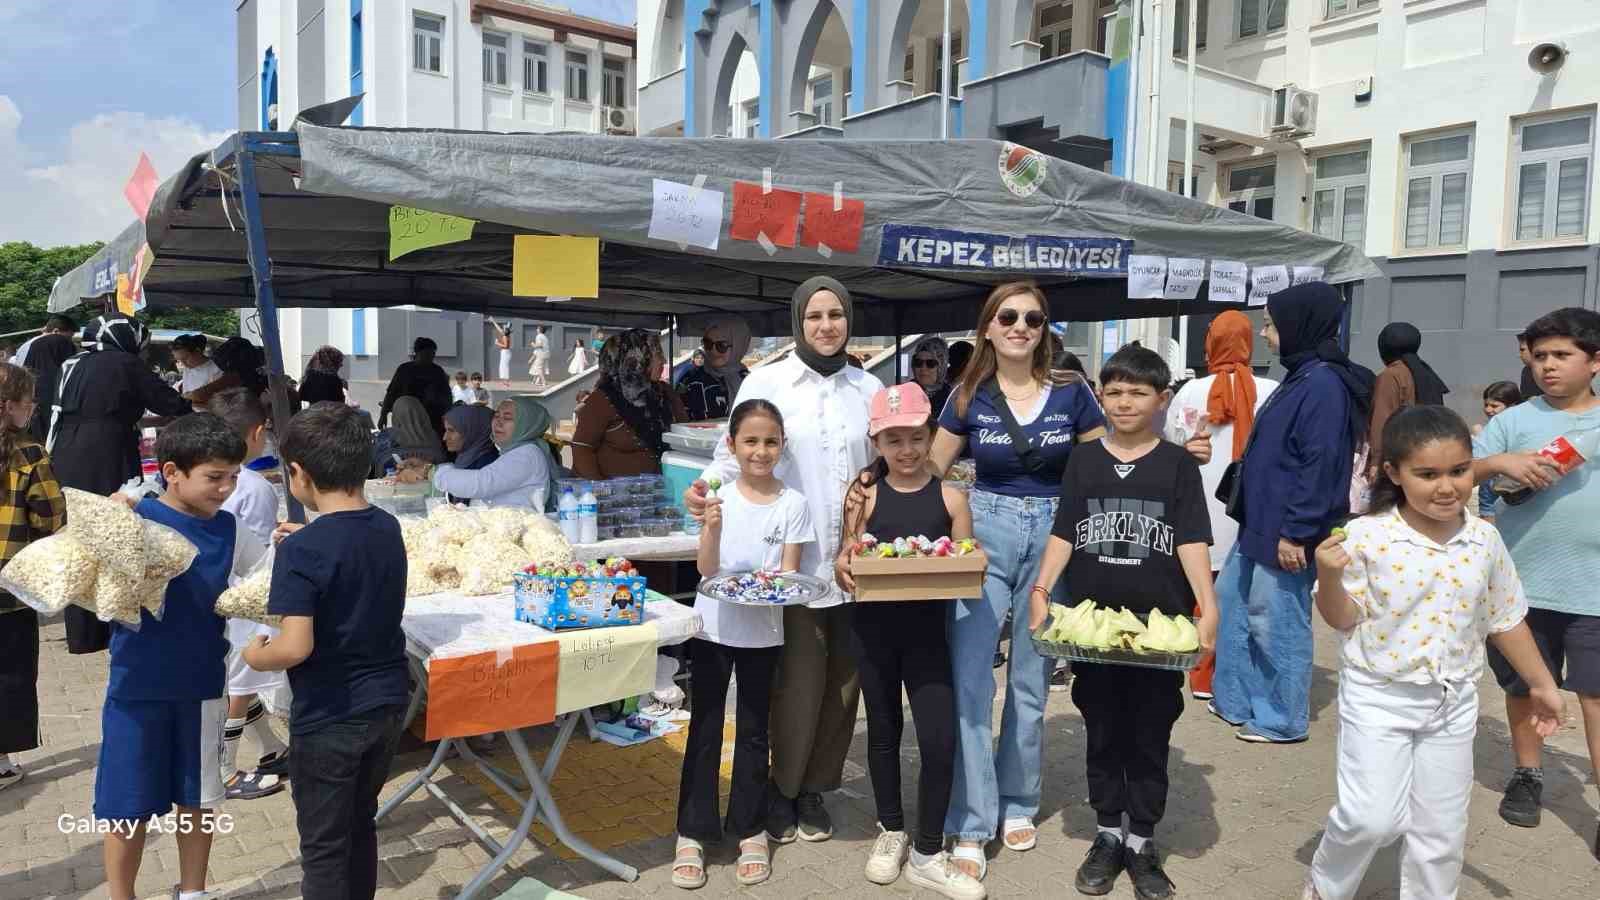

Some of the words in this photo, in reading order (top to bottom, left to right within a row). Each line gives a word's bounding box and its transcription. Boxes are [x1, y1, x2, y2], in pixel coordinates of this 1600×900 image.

[897, 237, 986, 267] KEPEZ
[992, 242, 1121, 269] BELEDİYESİ
[1039, 428, 1071, 448] Team
[1075, 511, 1175, 556] BRKLYN
